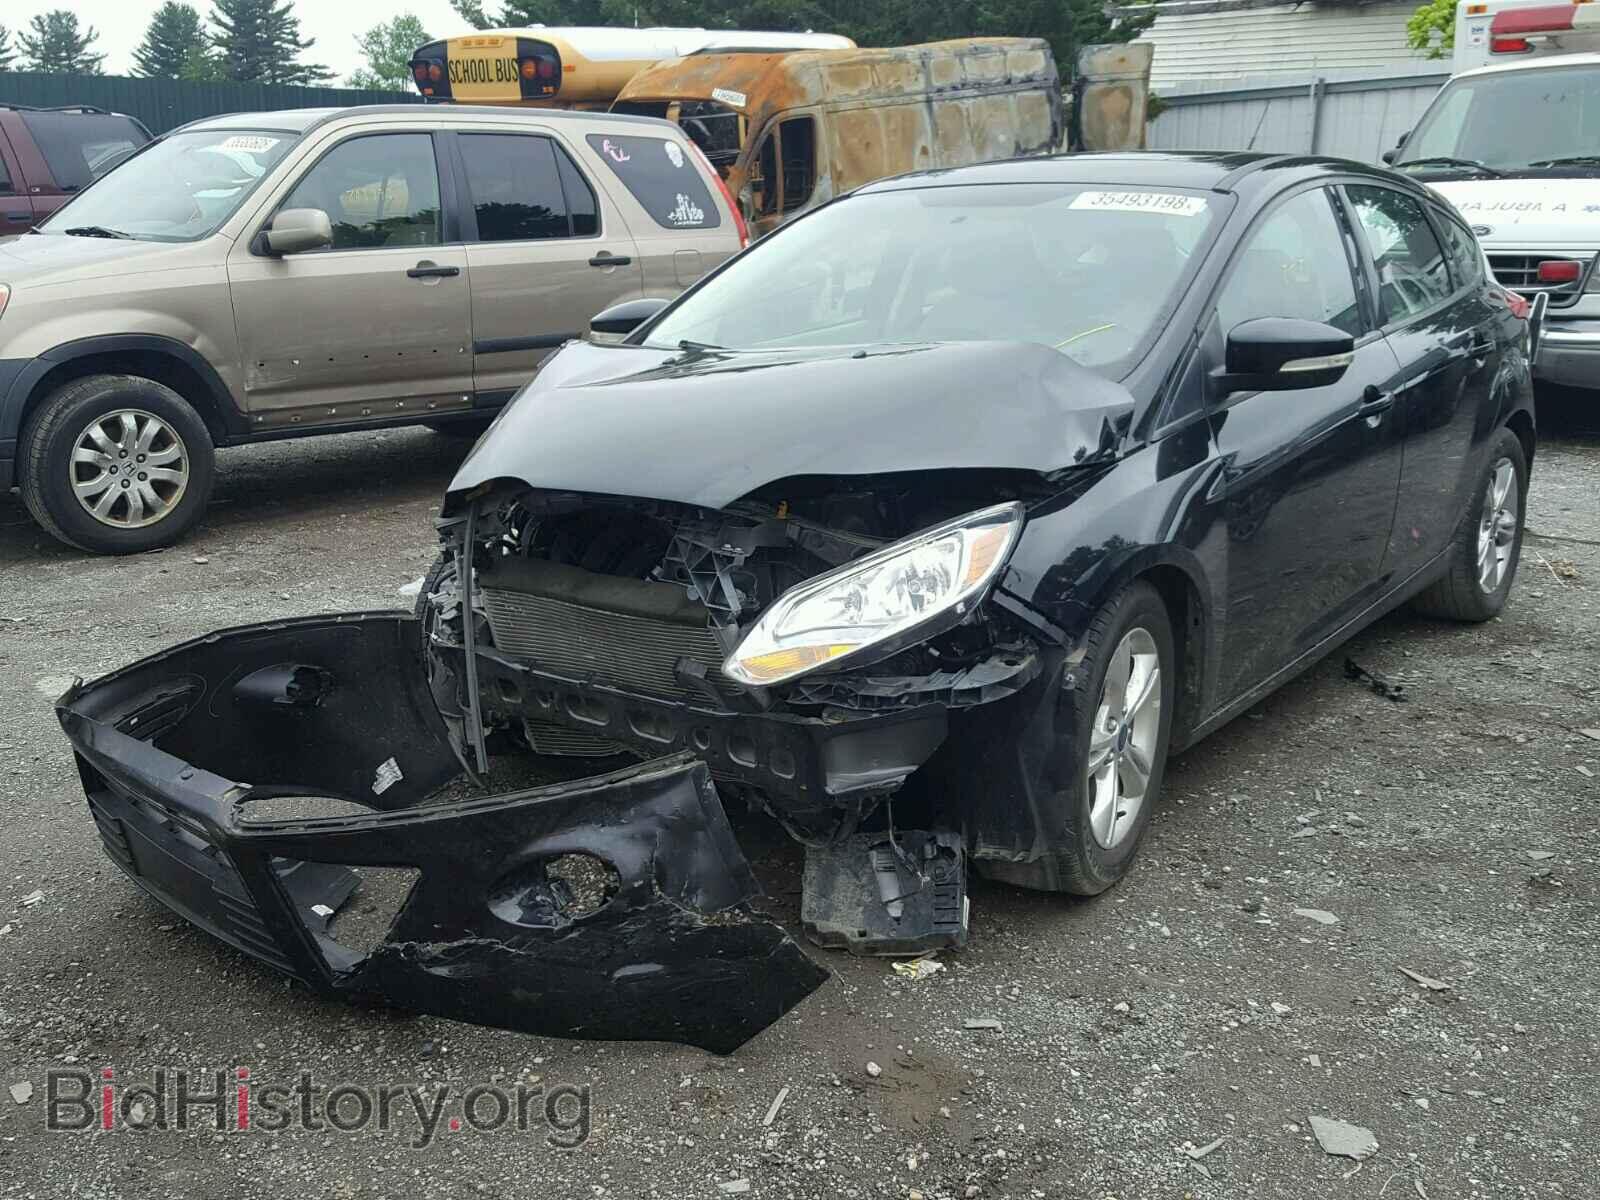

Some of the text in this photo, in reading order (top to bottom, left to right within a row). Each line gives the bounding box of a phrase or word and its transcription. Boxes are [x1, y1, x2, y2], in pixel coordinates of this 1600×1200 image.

[449, 58, 518, 83] SCHOOL BUS
[1091, 192, 1187, 210] 35493198
